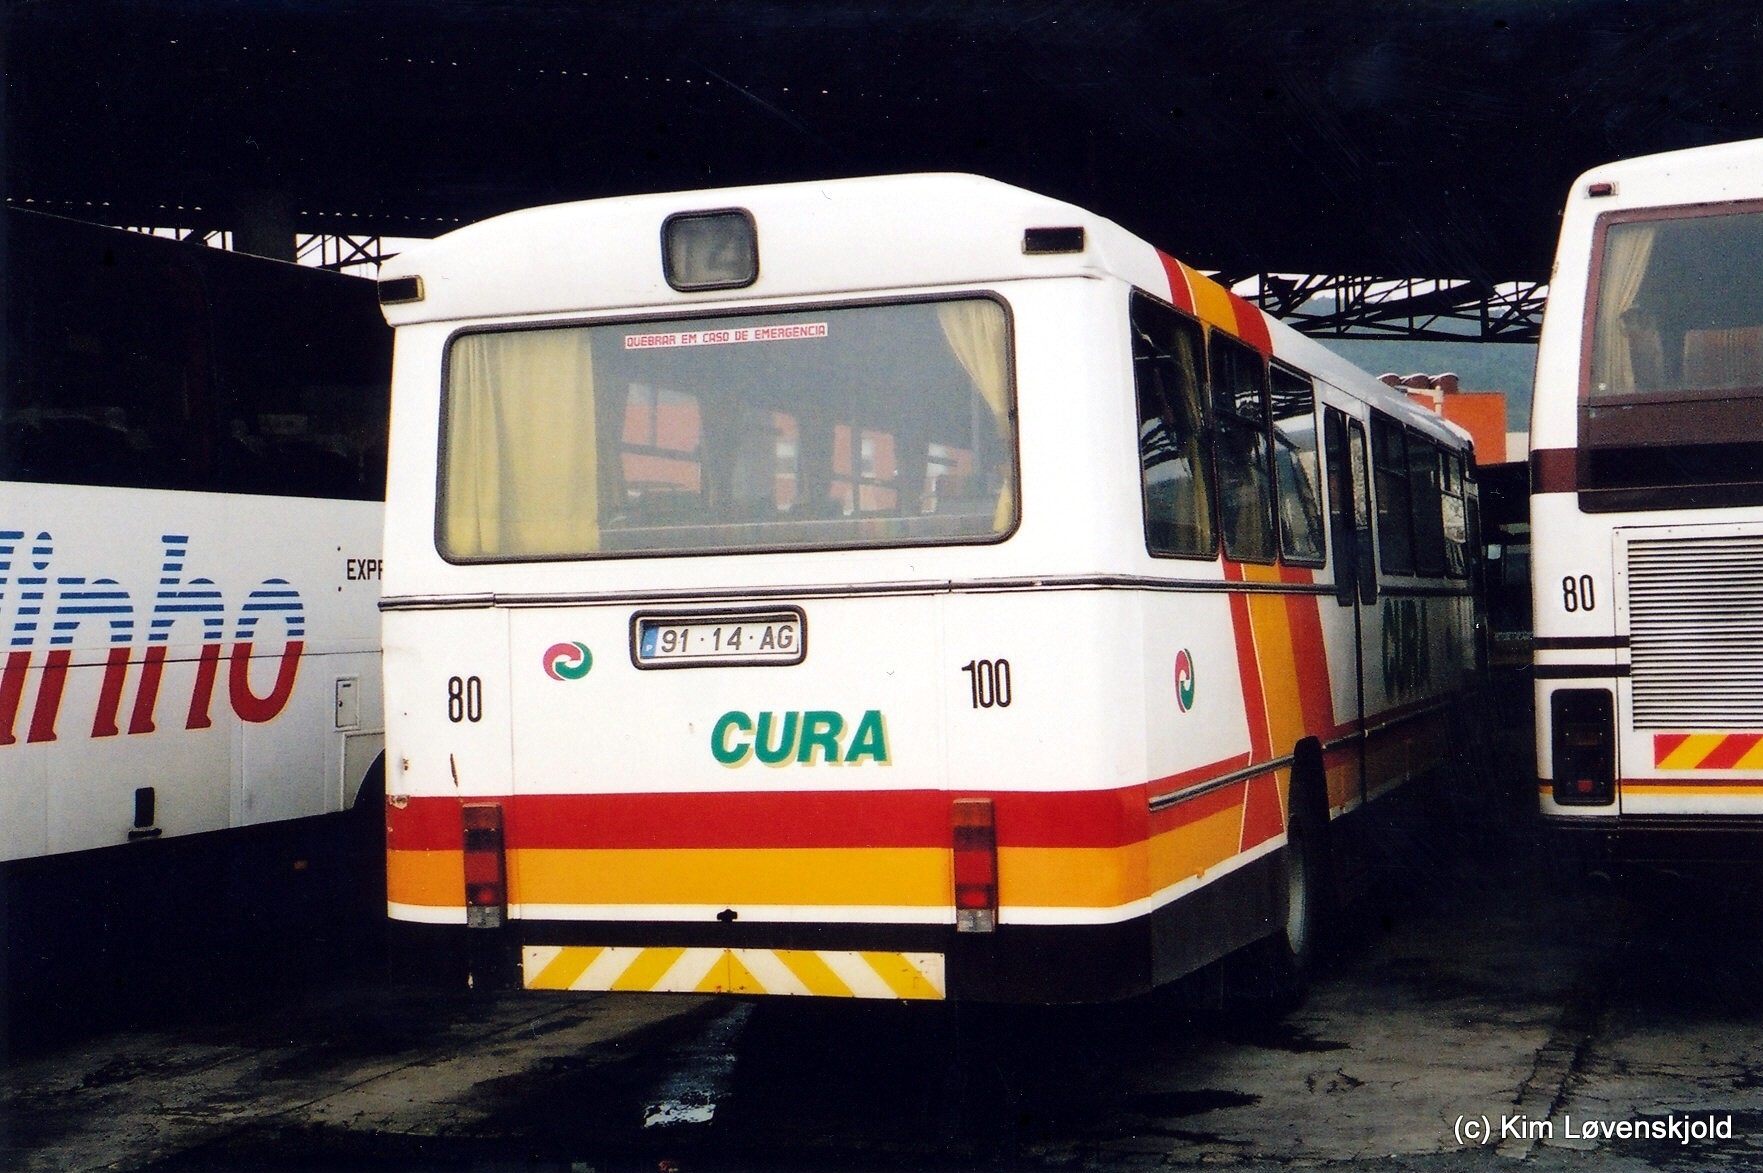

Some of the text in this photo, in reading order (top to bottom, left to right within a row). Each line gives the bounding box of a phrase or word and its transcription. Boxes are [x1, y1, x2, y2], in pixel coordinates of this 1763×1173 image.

[626, 325, 826, 347] QUEBRAR EM CASO DE EMERGENCIA
[1562, 574, 1595, 613] 80
[448, 675, 482, 723] 80
[961, 658, 1012, 709] 100
[710, 709, 891, 768] CURA
